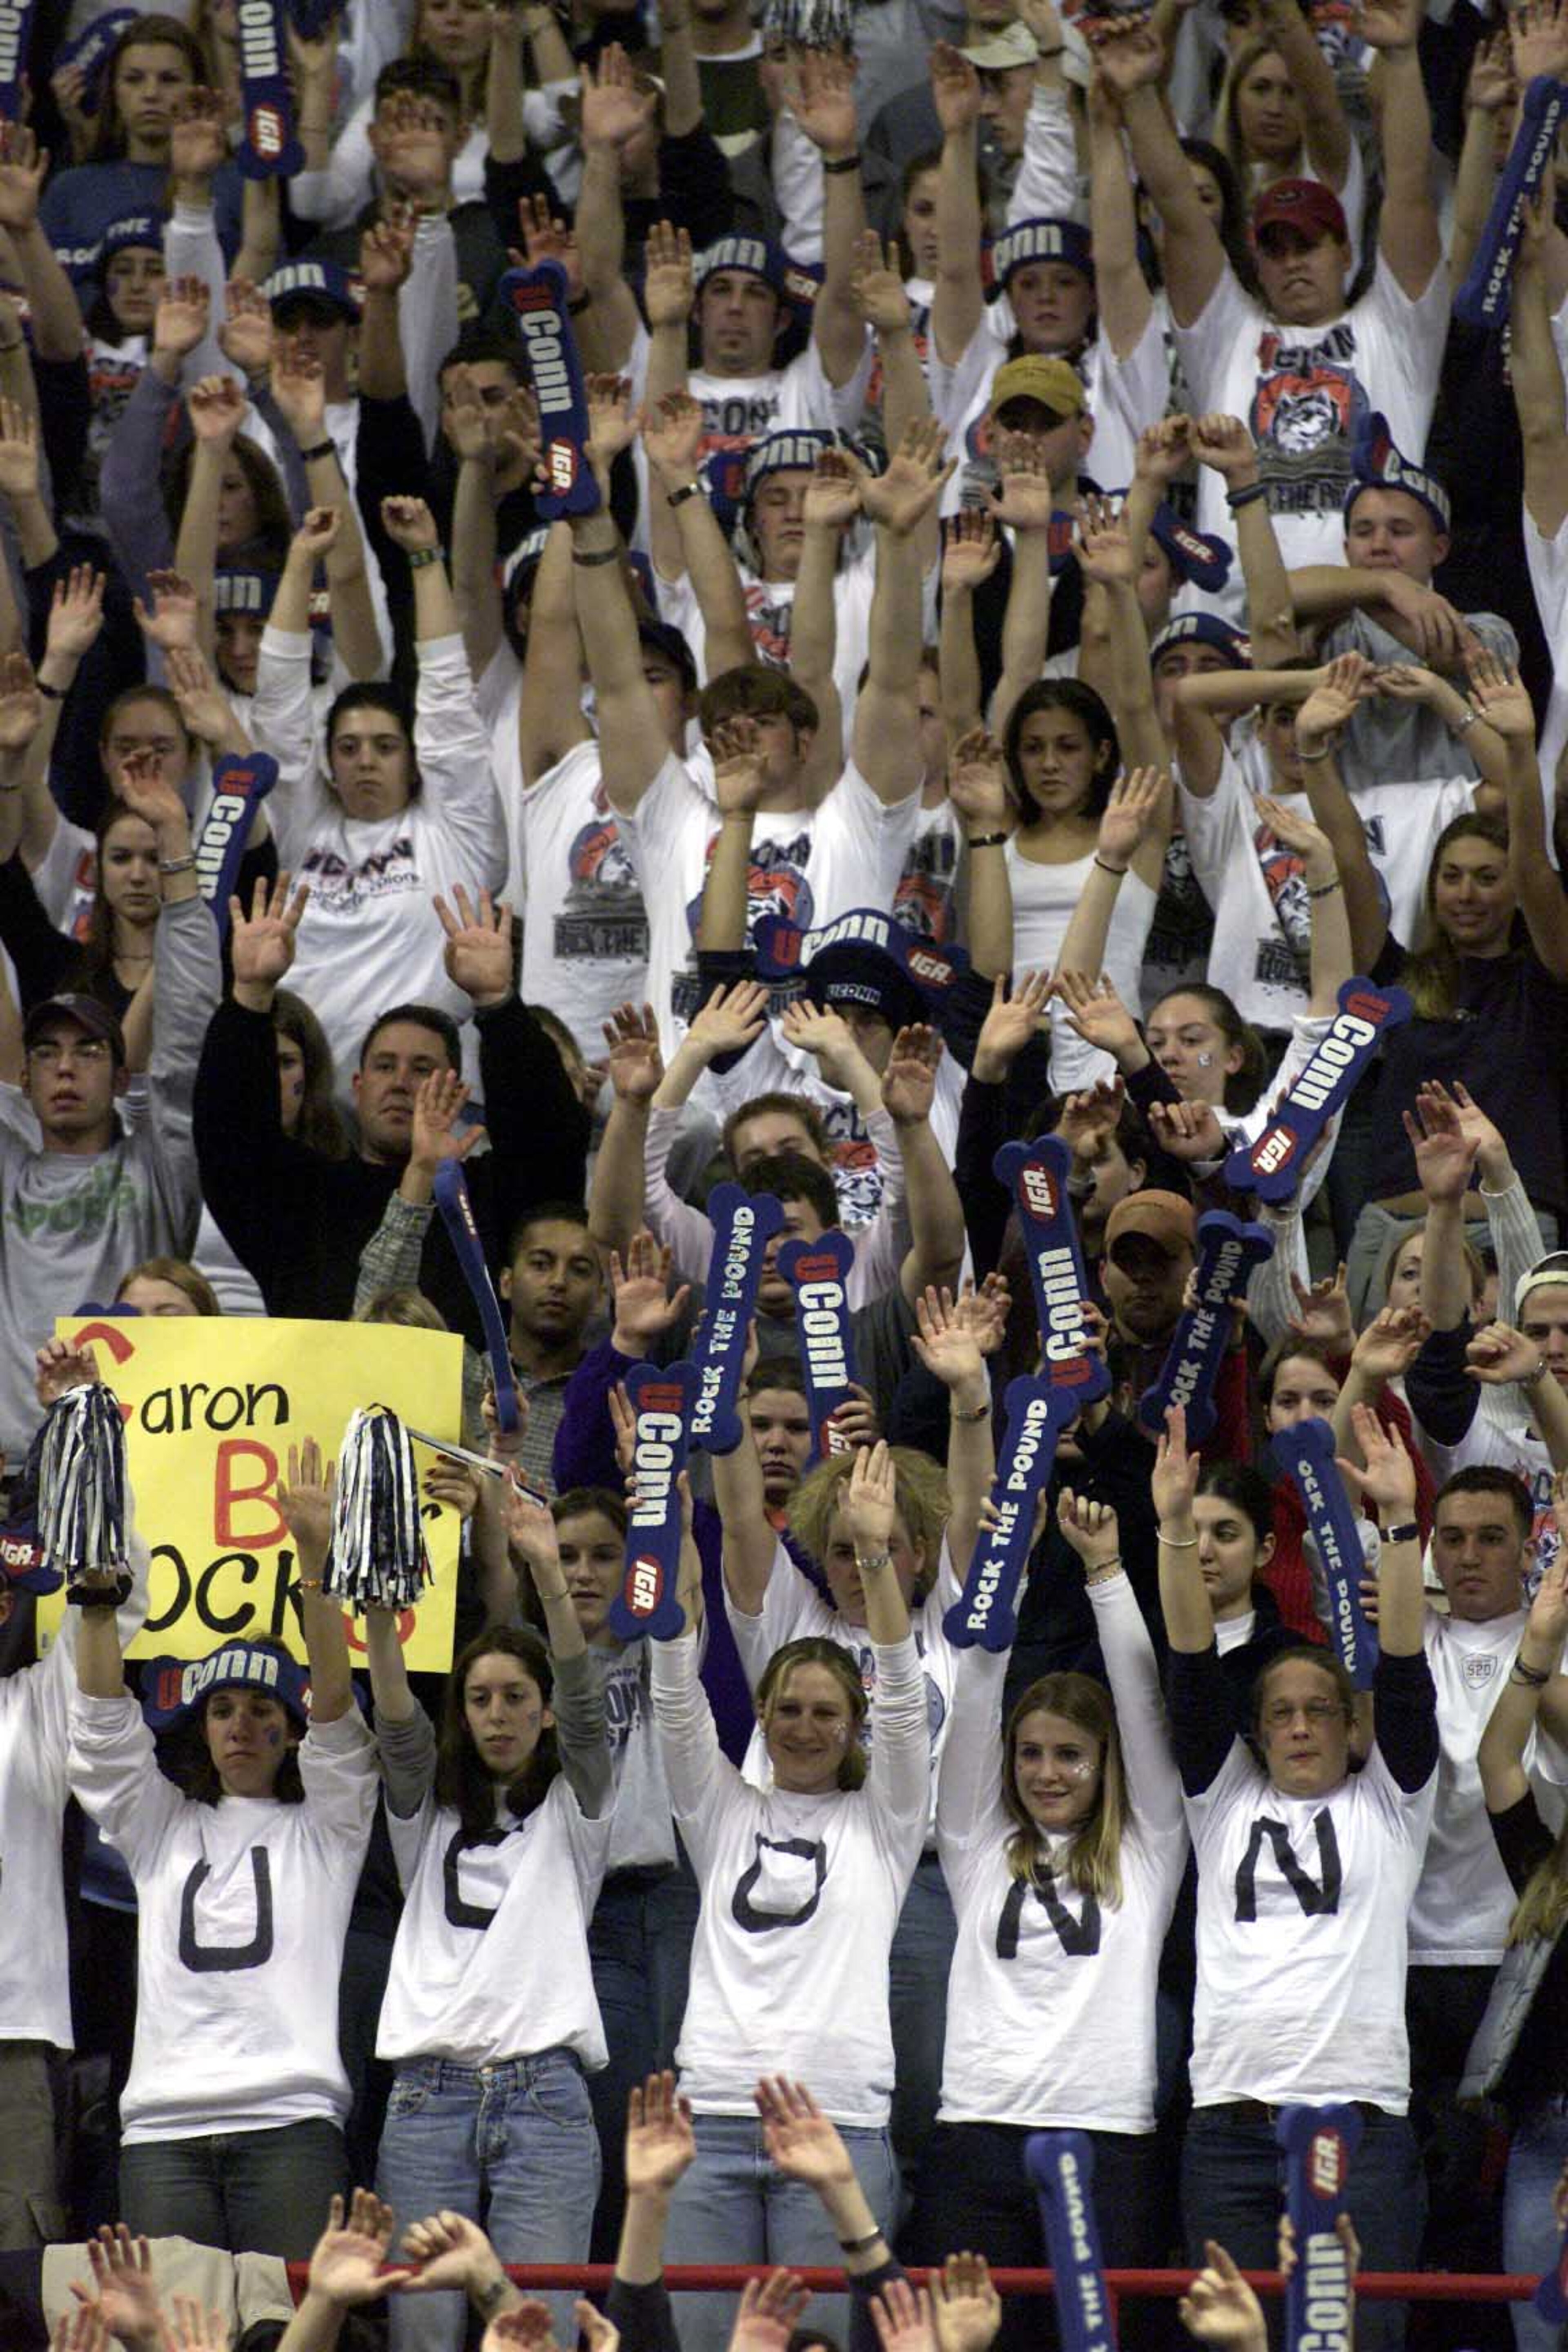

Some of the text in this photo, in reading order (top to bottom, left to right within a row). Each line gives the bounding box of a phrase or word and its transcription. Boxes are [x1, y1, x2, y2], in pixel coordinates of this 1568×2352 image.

[512, 285, 573, 414] UConn
[550, 442, 573, 491] IGA
[827, 982, 882, 1004] UCONN
[909, 951, 953, 984] IGA
[1290, 992, 1394, 1111] UConn
[1022, 1167, 1055, 1216] IGA
[1254, 1129, 1292, 1175] IGA
[691, 1206, 755, 1433] ROCK THE POUND
[795, 1254, 849, 1388] UConn
[1038, 1247, 1091, 1387] UConn
[1170, 1240, 1244, 1406] OCK THE POUND
[631, 1383, 683, 1527] UConn
[967, 1399, 1049, 1630] ROCK THE POUND
[1297, 1459, 1325, 1512] OCK
[1320, 1520, 1343, 1569] THE
[631, 1560, 658, 1610] IGA
[158, 1647, 280, 1711] UConn
[179, 1846, 273, 1973] U
[731, 1832, 827, 1933] O
[996, 1863, 1101, 1960] N
[1234, 1806, 1343, 1923] N
[1058, 2152, 1092, 2262] POUND
[1312, 2135, 1339, 2193] IGA
